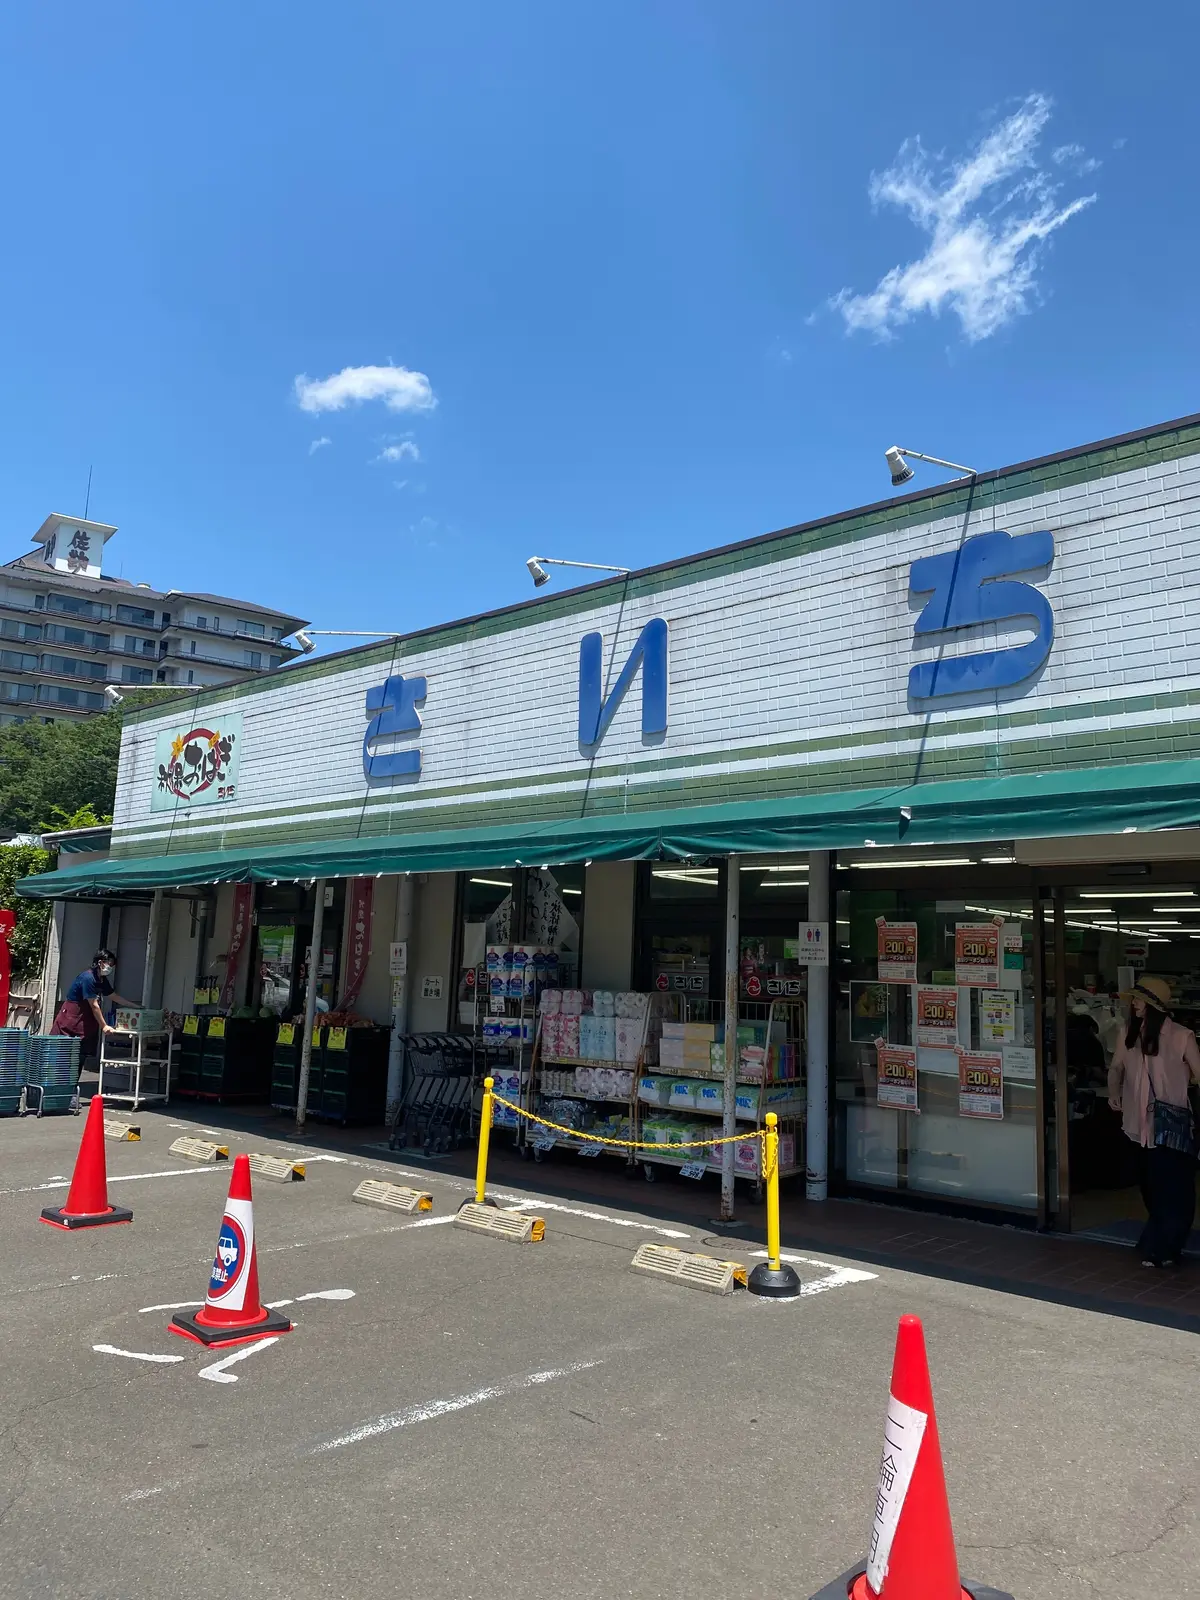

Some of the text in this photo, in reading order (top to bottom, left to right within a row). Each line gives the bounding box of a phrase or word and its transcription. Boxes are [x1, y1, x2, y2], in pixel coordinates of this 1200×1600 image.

[425, 978, 440, 986] カート
[424, 988, 440, 997] 置き場
